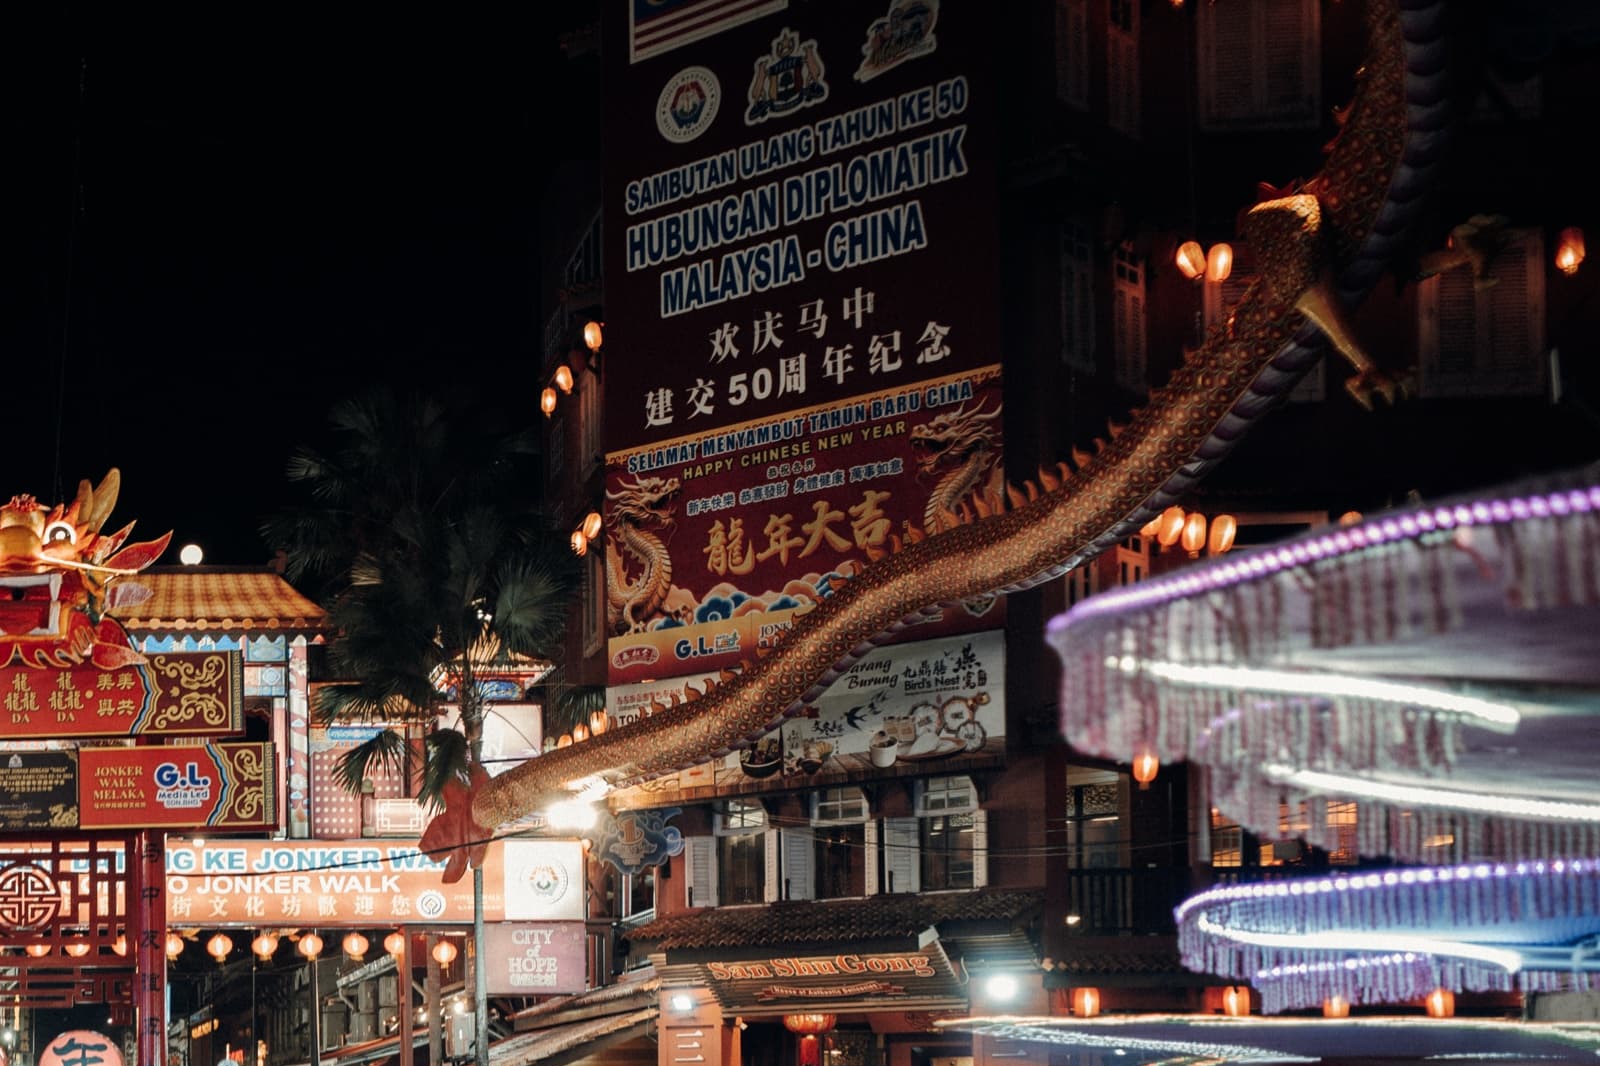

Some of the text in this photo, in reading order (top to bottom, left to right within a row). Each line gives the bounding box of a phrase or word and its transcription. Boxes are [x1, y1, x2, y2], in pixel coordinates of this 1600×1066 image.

[626, 76, 968, 215] SAMBUTAN ULANG TAHUN KE 50
[627, 124, 968, 272] HUBUNGAN DIPLOMATIK
[661, 238, 802, 318] MALAYSIA
[825, 200, 927, 274] CHINA
[709, 287, 876, 365] 欢庆马中
[643, 320, 953, 432] 建交50周年纪念
[628, 379, 974, 475] SELAMAT MENYAMBUT TAHUN BARU CINA
[683, 420, 908, 481] HAPPY CHINESE NEW YEAR
[766, 458, 816, 480] 恭祝各界
[686, 456, 904, 518] 新年快樂 恭喜發財 身體健康 萬事如意
[703, 490, 895, 576] 龍年大吉
[676, 637, 715, 660] G.L.
[96, 673, 136, 691] 美美
[844, 672, 900, 691] Burung
[904, 677, 932, 693] Bird's
[934, 674, 961, 689] Nest
[12, 711, 30, 724] DA
[57, 709, 75, 723] DA
[94, 766, 143, 777] JONKER
[99, 777, 136, 788] WALK
[156, 764, 210, 787] G.L.
[93, 788, 145, 800] MELAKA
[158, 789, 209, 800] Media Led
[204, 850, 247, 871] KE
[259, 849, 380, 873] JONKER
[196, 875, 313, 895] JONKER
[319, 873, 401, 894] WALK
[511, 928, 554, 946] CITY
[526, 944, 542, 958] of
[507, 956, 559, 974] HOPE
[706, 961, 772, 981] San
